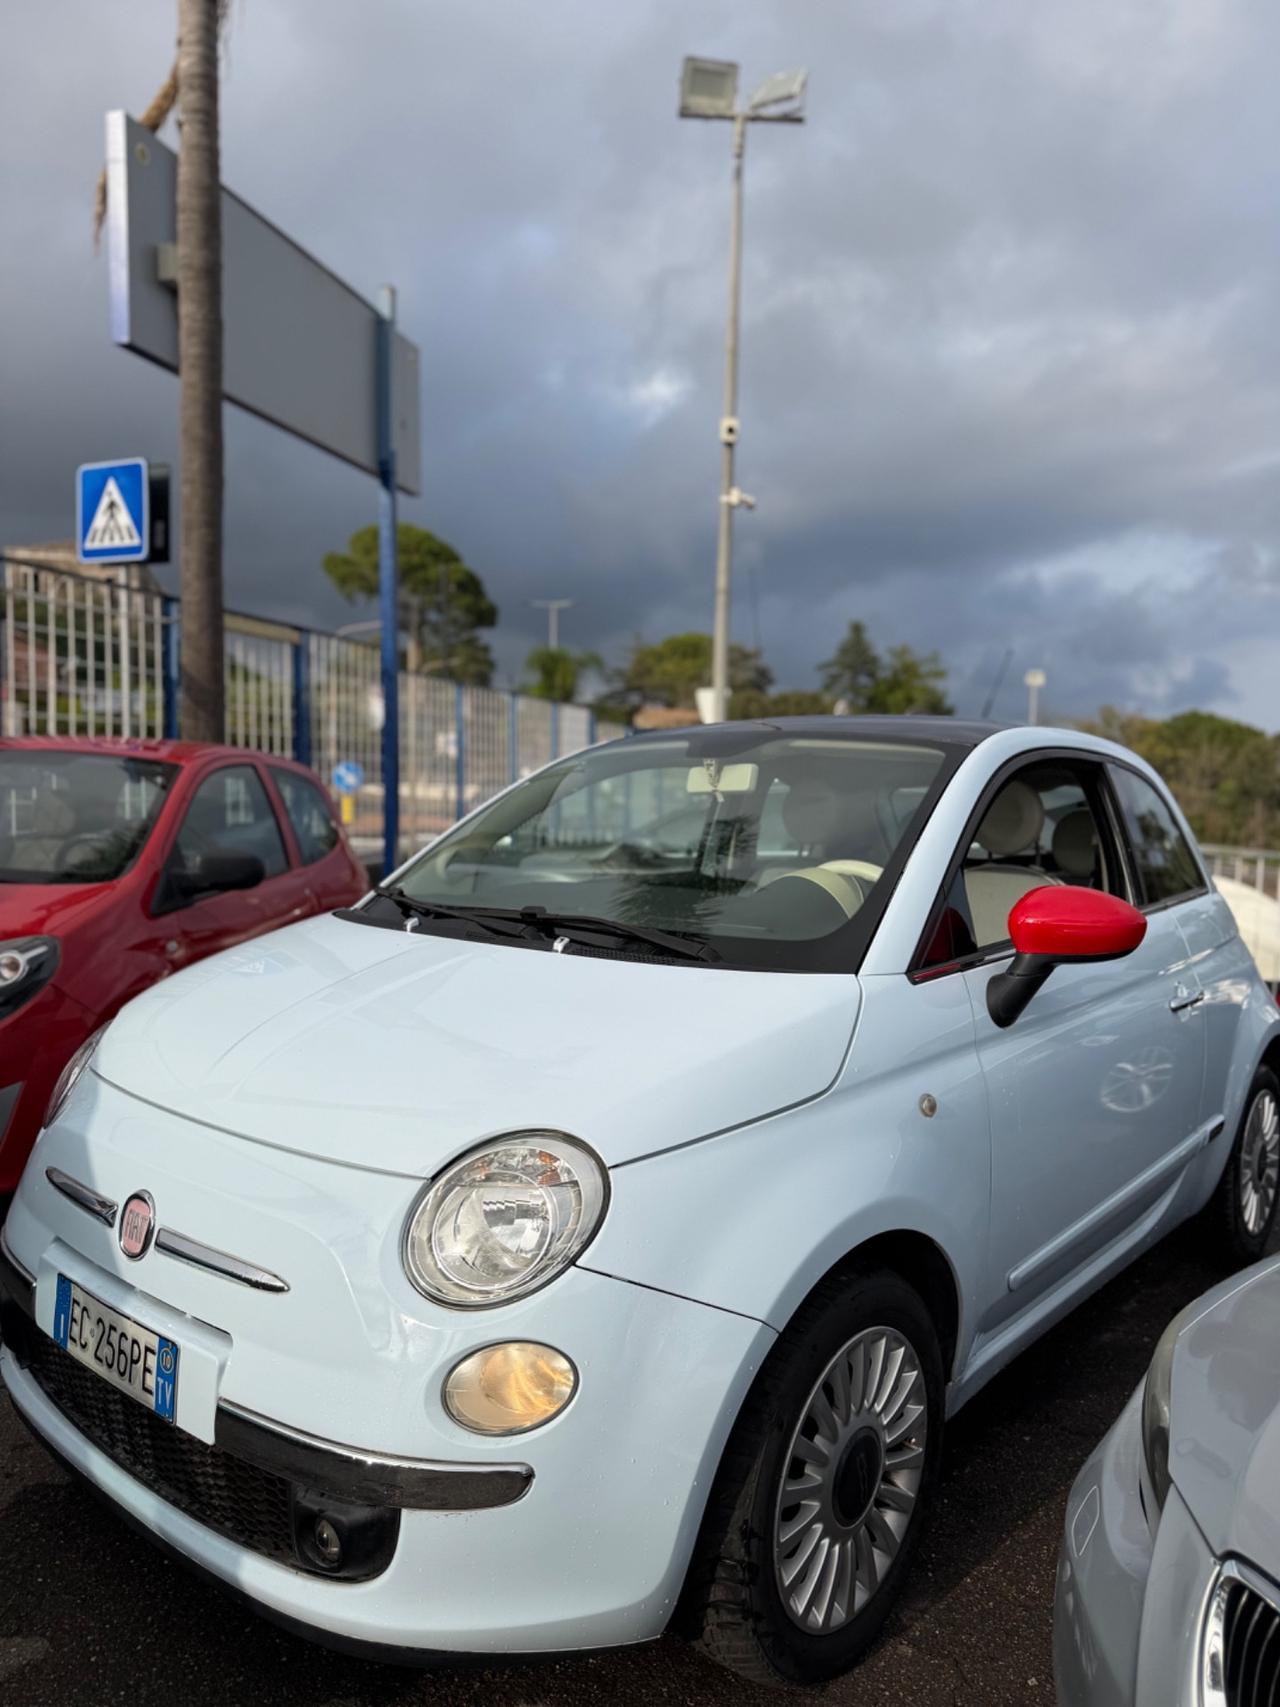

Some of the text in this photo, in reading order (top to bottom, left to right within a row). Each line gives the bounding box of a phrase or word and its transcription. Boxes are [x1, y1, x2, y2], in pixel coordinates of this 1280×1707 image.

[125, 1208, 149, 1244] FIAT
[69, 1298, 156, 1395] EC 256PE
[157, 1377, 172, 1409] TV
